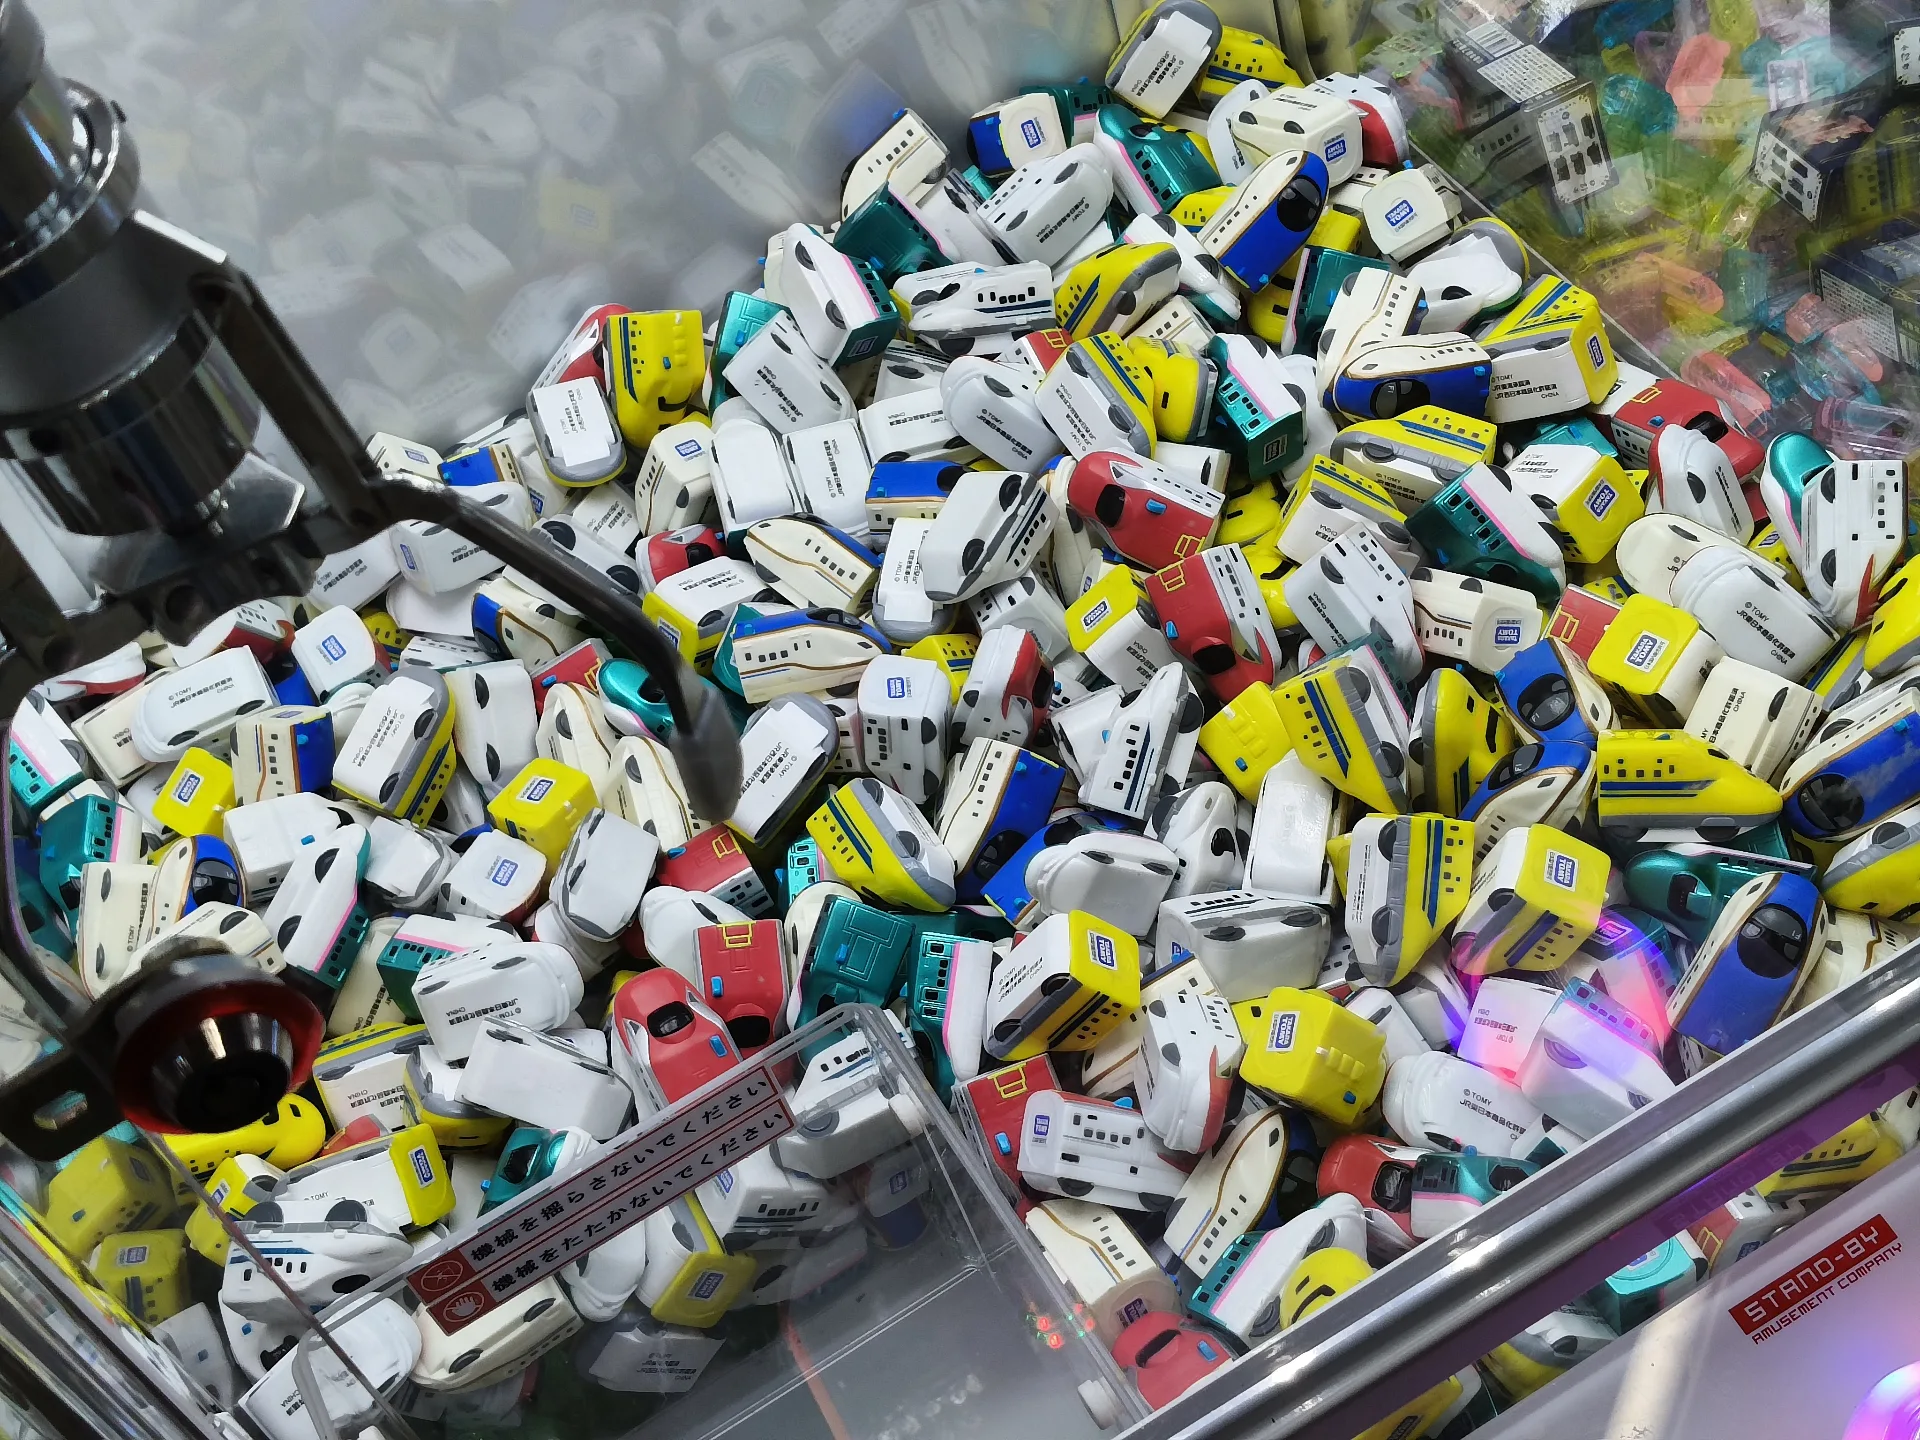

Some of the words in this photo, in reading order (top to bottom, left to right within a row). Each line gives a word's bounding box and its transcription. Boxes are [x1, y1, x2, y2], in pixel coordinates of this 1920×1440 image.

[1026, 121, 1039, 142] TOMY
[1326, 142, 1344, 153] TOMY
[1070, 207, 1085, 222] TOMY
[1385, 201, 1409, 220] TAKARA
[1389, 206, 1413, 225] TOMY
[1590, 341, 1601, 367] TOMY
[762, 364, 777, 380] CHINA
[1496, 373, 1513, 381] TOMY
[1059, 382, 1072, 399] CHINA
[777, 402, 791, 417] TOMY
[986, 412, 1003, 426] TOMY
[678, 443, 698, 455] TOMY
[1011, 446, 1028, 460] CHINA
[1591, 487, 1610, 509] TOMY
[1595, 490, 1615, 513] TAKARA
[1319, 524, 1337, 536] CHINA
[1312, 591, 1327, 610] CHINA
[1085, 605, 1106, 624] TOMY
[1750, 606, 1769, 623] TOMY
[323, 640, 342, 659] TOMY
[1329, 634, 1341, 648] OMY
[1629, 634, 1649, 662] TAKARA
[1634, 639, 1654, 664] TOMY
[1770, 648, 1788, 665] CHINA
[175, 686, 192, 697] TOMY
[1732, 690, 1746, 712] CHINA
[1699, 727, 1709, 739] MY
[740, 740, 782, 795] JR西日本商品化許諾
[777, 760, 792, 778] TOMY
[179, 775, 195, 798] TOMY
[528, 780, 547, 800] TOMY
[534, 780, 552, 801] TAKARA
[495, 860, 510, 882] TOMY
[501, 863, 516, 886] TAKARA
[1556, 857, 1565, 883] TOMY
[1098, 939, 1106, 963] TOMY
[1104, 939, 1112, 965] TAKARA
[445, 1006, 465, 1017] CHINA
[497, 1009, 513, 1018] TOM
[1276, 1015, 1288, 1045] TOMY
[1282, 1016, 1294, 1046] TAKARA
[347, 1088, 368, 1099] CHINA
[1470, 1092, 1492, 1106] TOMY
[416, 1154, 429, 1181] TOMY
[471, 1080, 767, 1262] 機械を揺らさないでください
[310, 1191, 329, 1201] TOMY
[492, 1112, 783, 1292] 機械をたたかないでください
[1744, 1226, 1879, 1322] STAND-BY
[696, 1273, 715, 1297] TOMY
[1752, 1286, 1835, 1344] AMUSEMENT
[1837, 1243, 1902, 1290] COMPANY
[279, 1389, 300, 1408] CHINA
